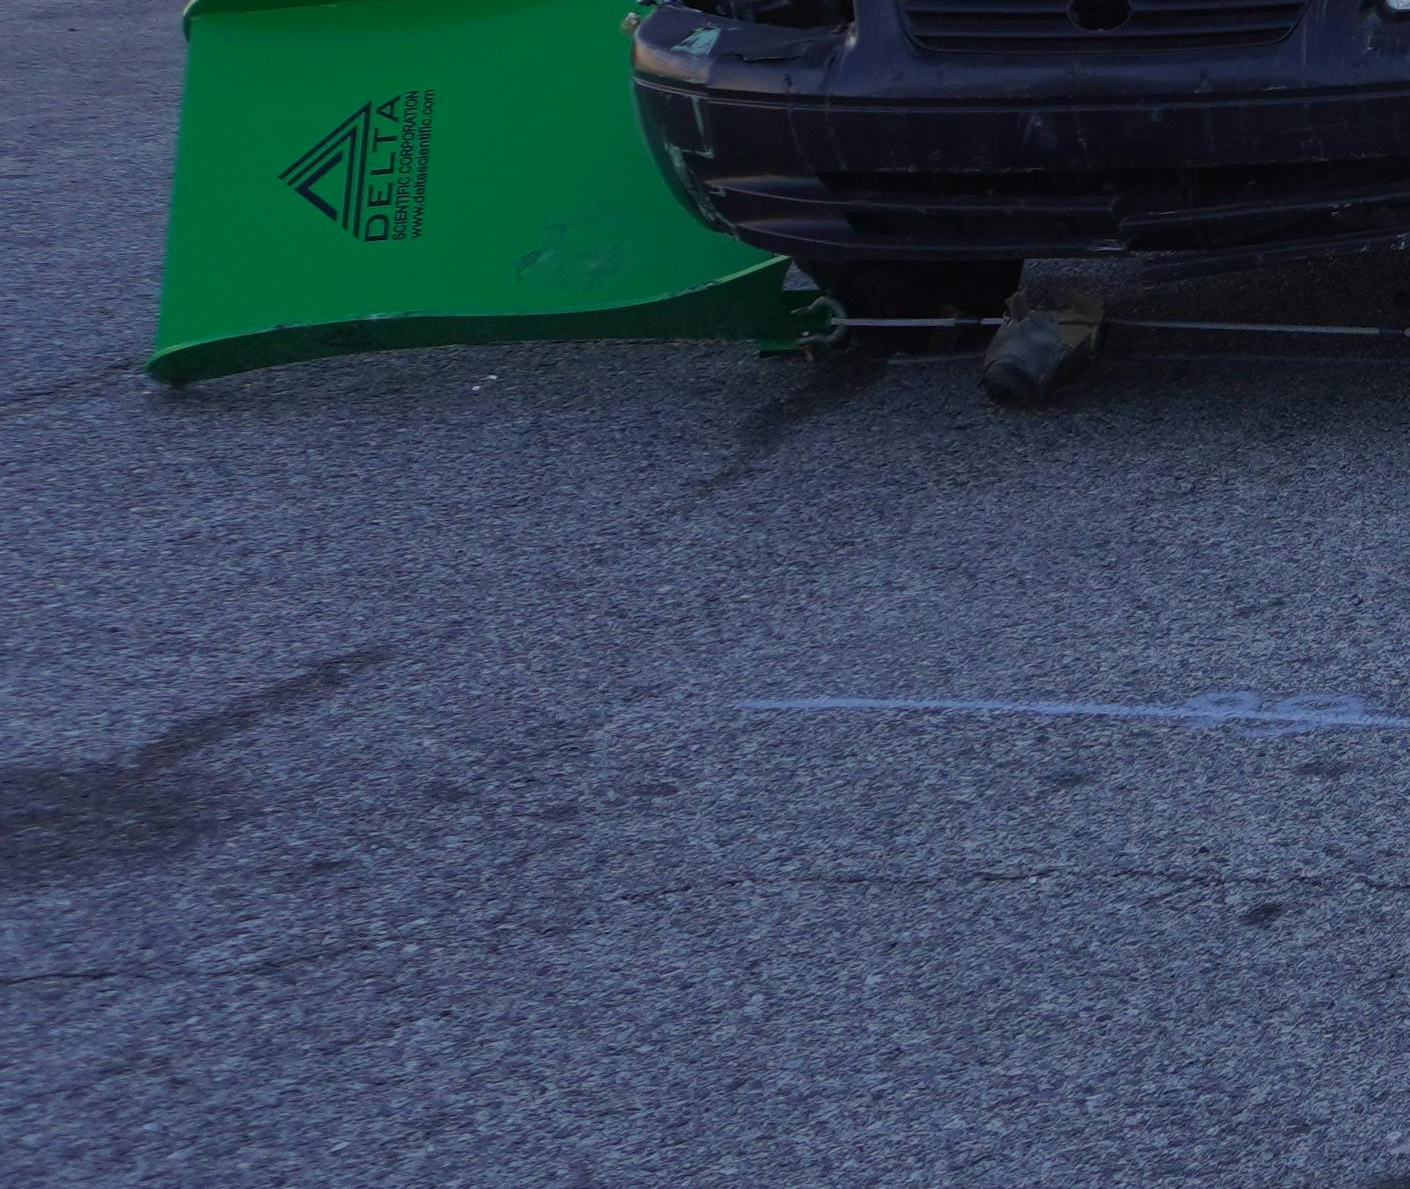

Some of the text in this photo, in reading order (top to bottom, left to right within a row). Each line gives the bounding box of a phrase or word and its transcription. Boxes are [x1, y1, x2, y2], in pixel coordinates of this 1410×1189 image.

[364, 94, 401, 242] DELTA
[392, 90, 419, 241] SCIENTIFIC CORPORATION
[411, 89, 435, 239] www.deltascientific.com
